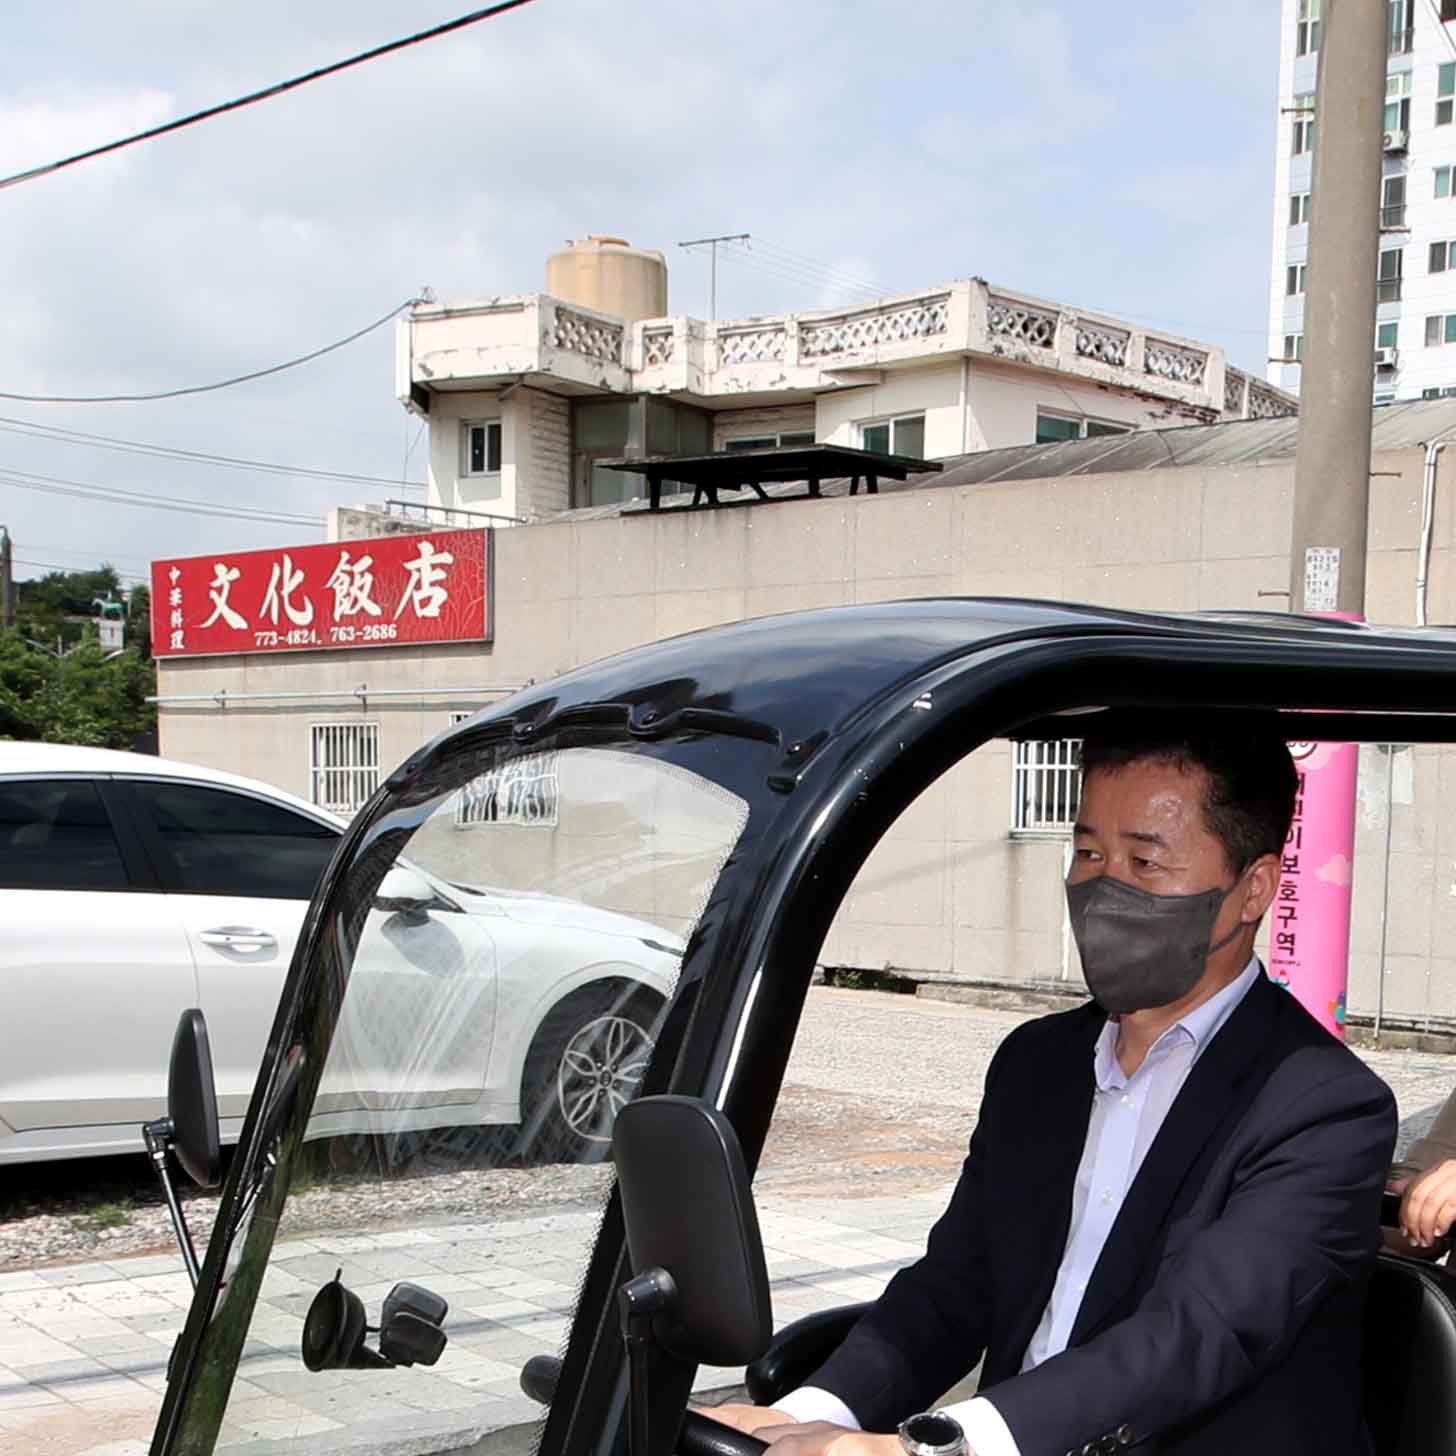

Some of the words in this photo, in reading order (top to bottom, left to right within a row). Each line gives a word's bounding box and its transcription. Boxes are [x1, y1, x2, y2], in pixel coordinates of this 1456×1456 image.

[194, 540, 456, 631] 文化飯店
[330, 623, 397, 642] 763-2686
